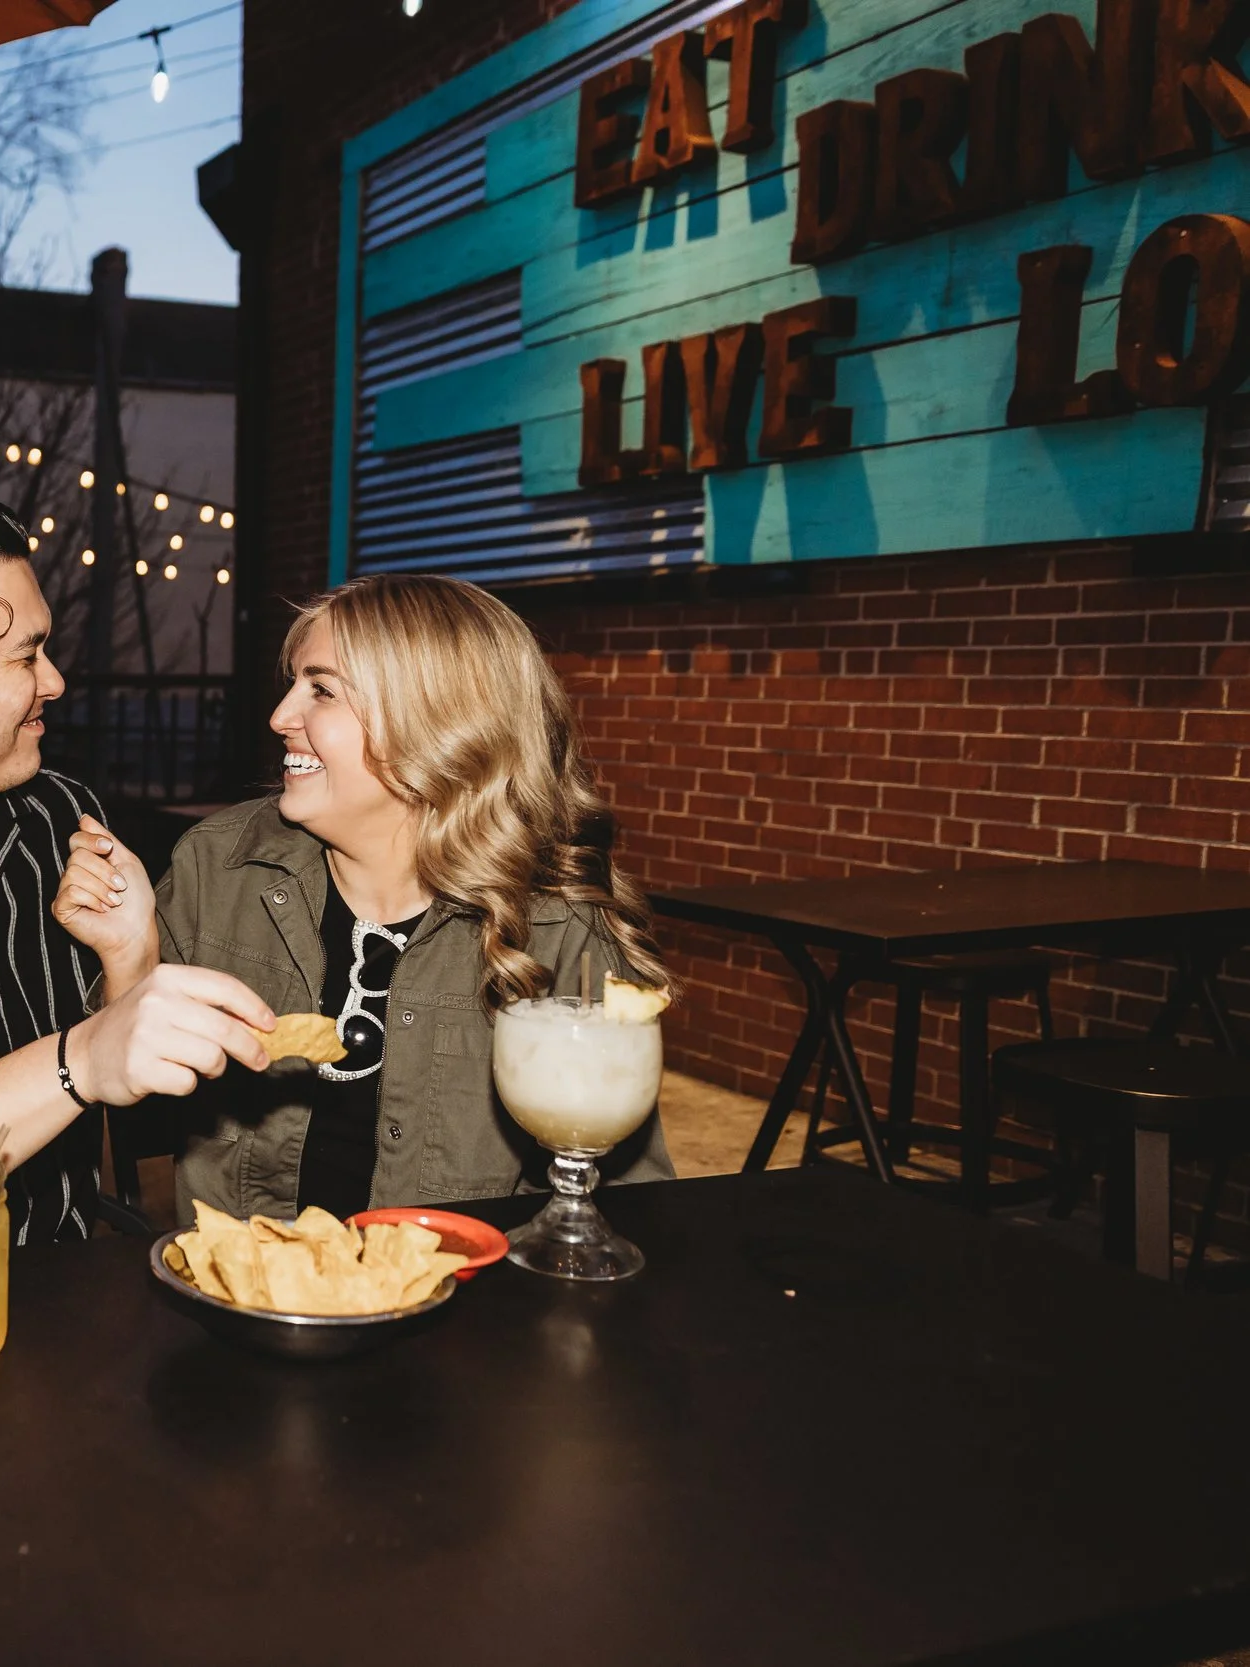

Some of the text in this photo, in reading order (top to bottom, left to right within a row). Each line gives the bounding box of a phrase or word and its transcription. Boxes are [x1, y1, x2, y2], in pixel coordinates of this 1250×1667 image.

[575, 0, 806, 208] EAT
[791, 0, 1250, 264] DRINK
[579, 297, 857, 486] LIVE
